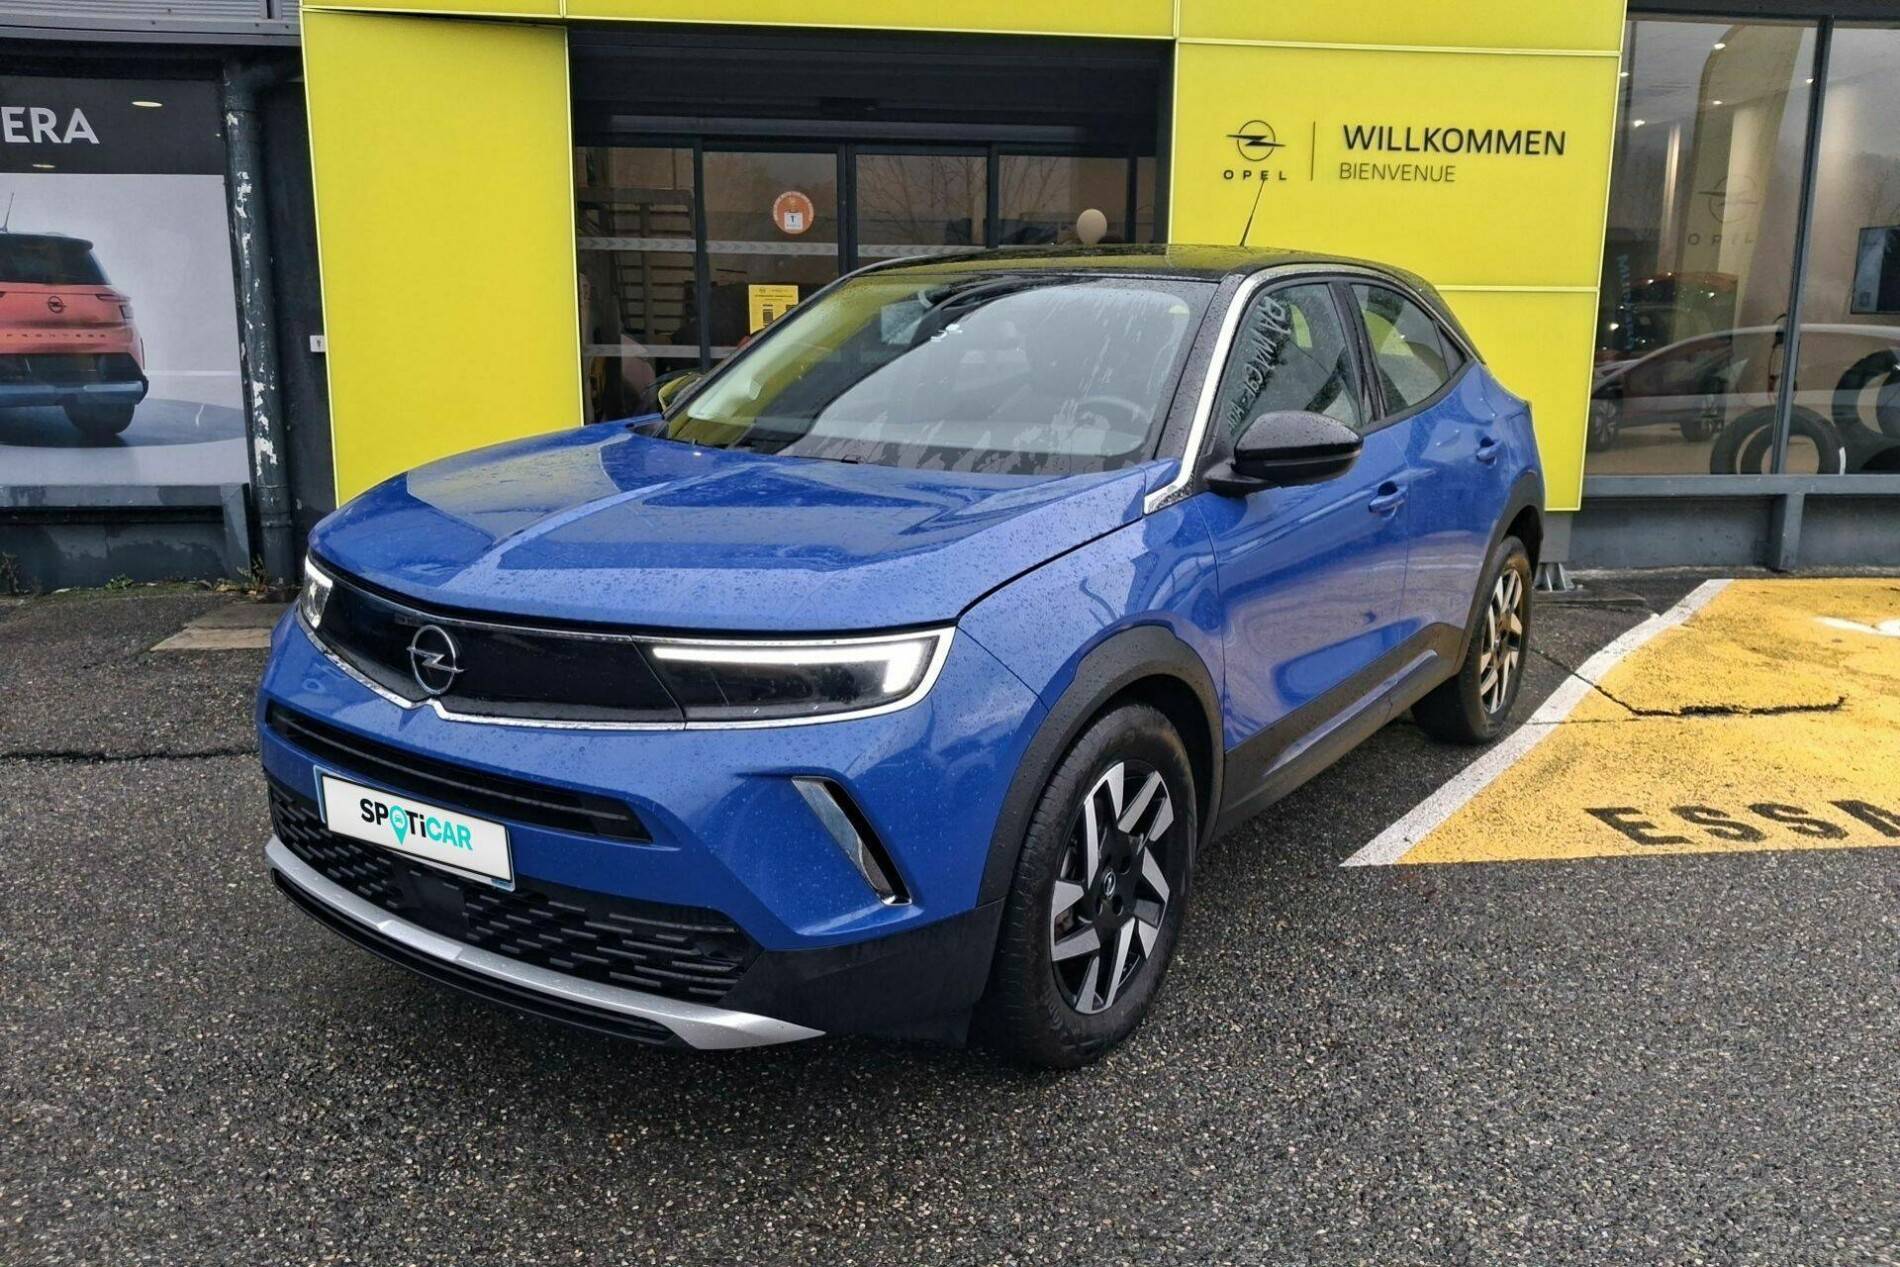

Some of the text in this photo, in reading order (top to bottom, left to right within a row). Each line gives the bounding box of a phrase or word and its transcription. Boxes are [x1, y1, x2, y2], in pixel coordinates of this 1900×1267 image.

[1343, 124, 1566, 156] WILLKOMMEN
[1223, 169, 1288, 181] OPEL
[1339, 161, 1456, 183] BIENVENUE
